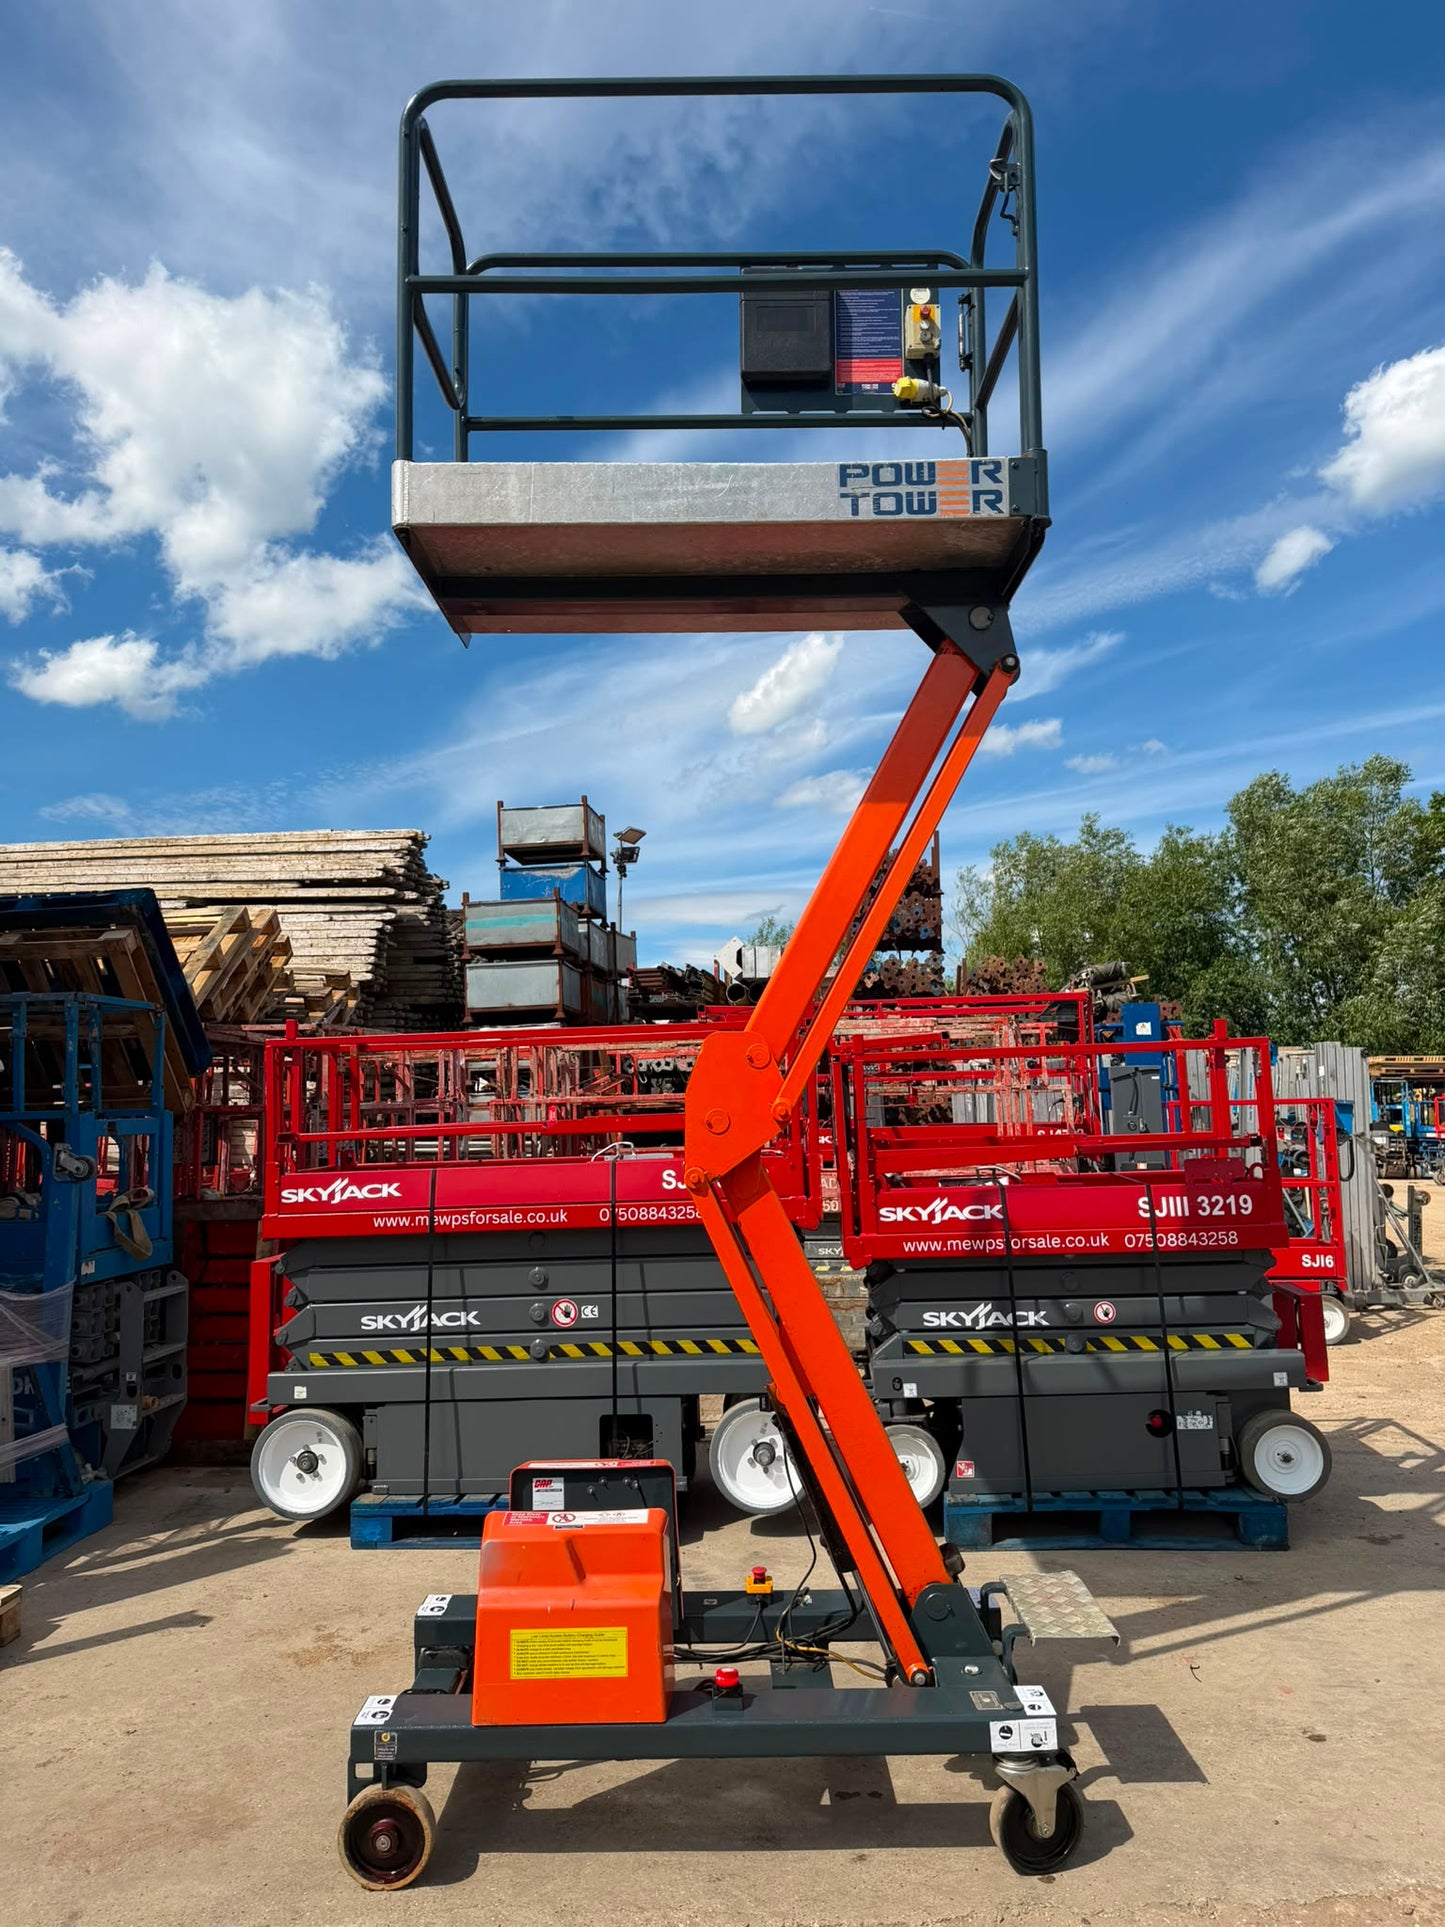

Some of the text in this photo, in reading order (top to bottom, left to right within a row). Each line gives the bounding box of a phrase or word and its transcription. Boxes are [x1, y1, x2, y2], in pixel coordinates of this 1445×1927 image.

[839, 460, 1003, 487] POWER
[839, 489, 1005, 516] TOWER
[281, 1177, 402, 1204] SKYJACK
[599, 1206, 703, 1222] 050884325
[879, 1197, 1004, 1224] SKYJACK
[1196, 1194, 1253, 1216] 3219
[902, 1231, 1239, 1253] www.mewpsorsale.co.uk 07508843258
[360, 1304, 482, 1332] SKYJACK
[922, 1302, 1051, 1330] SKYJACK
